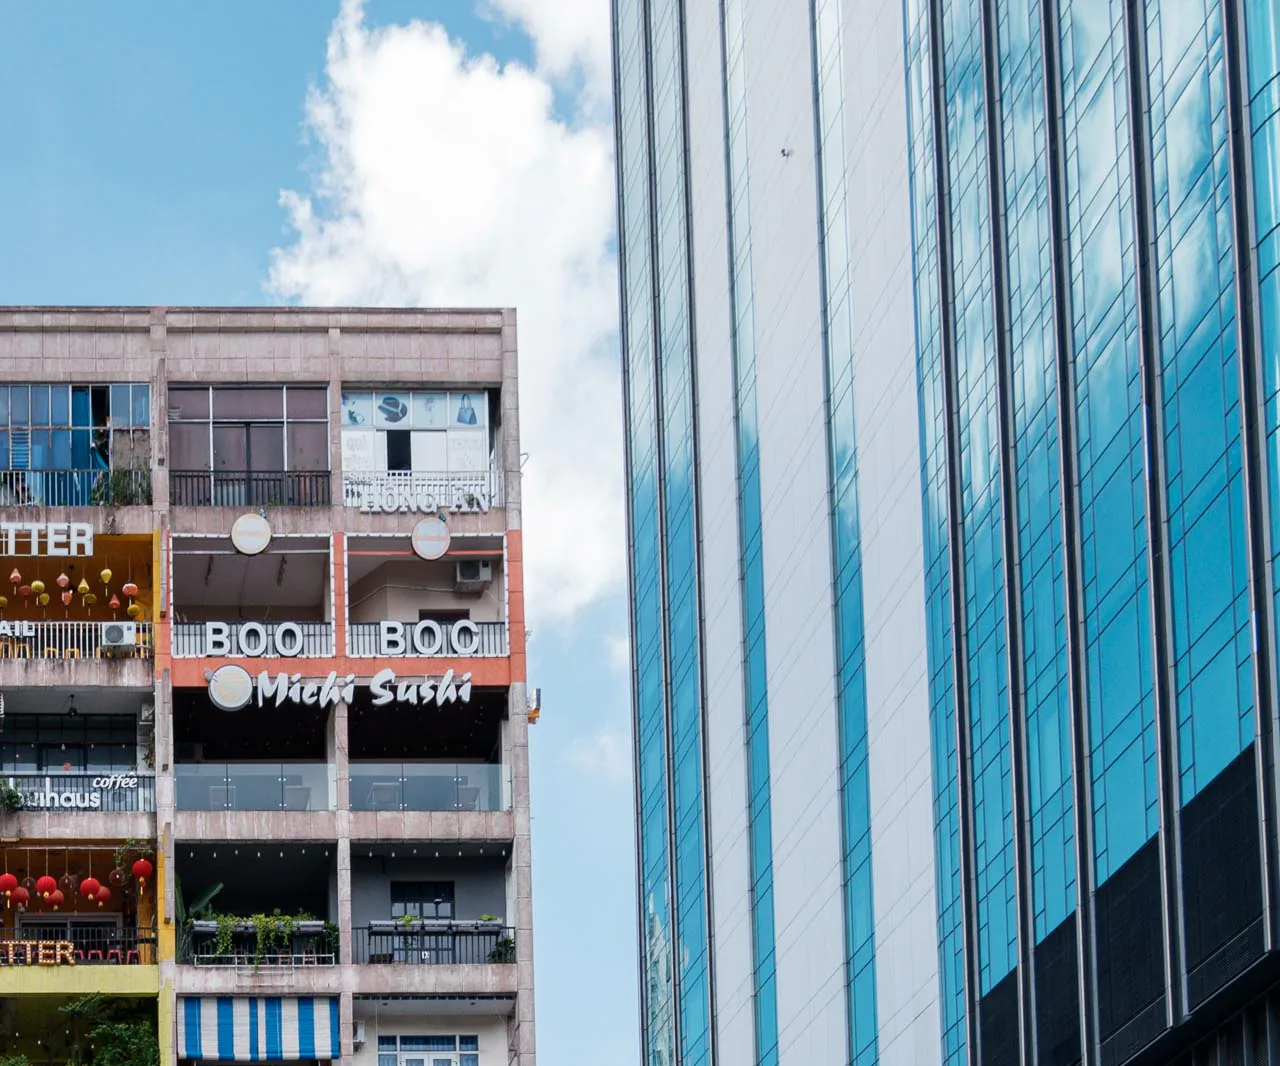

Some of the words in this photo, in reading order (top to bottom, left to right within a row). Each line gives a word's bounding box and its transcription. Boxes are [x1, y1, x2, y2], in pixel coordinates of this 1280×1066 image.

[205, 621, 303, 657] BOO
[257, 670, 355, 708] Michi
[371, 669, 472, 706] Sushi
[92, 772, 137, 790] coffee
